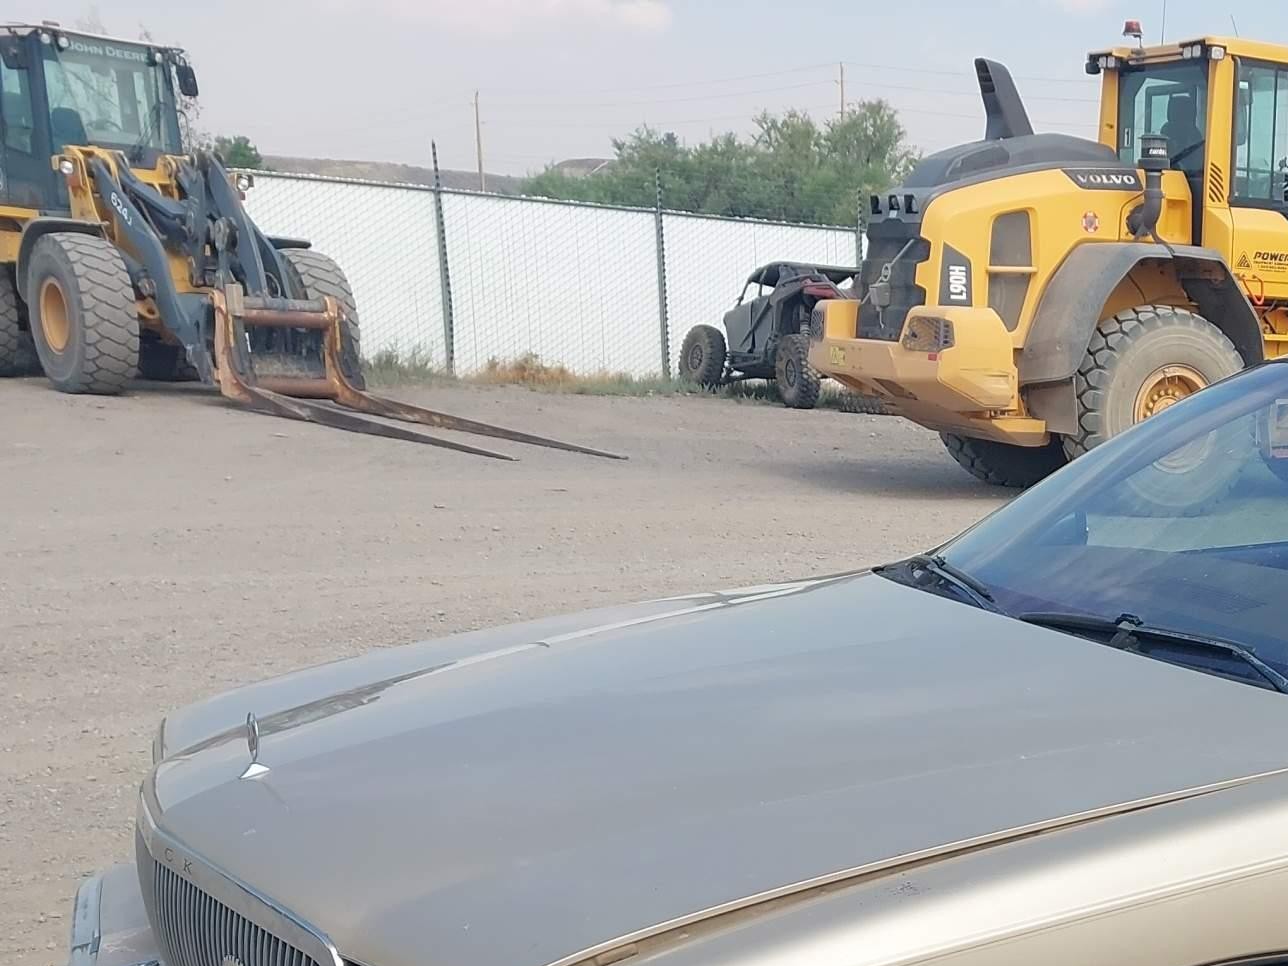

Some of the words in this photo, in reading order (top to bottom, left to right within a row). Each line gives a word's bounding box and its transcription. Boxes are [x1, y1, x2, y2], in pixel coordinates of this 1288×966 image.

[69, 41, 103, 56] JOHN
[1076, 173, 1136, 185] VOLVO
[110, 191, 132, 226] 624J
[949, 265, 967, 300] L90H
